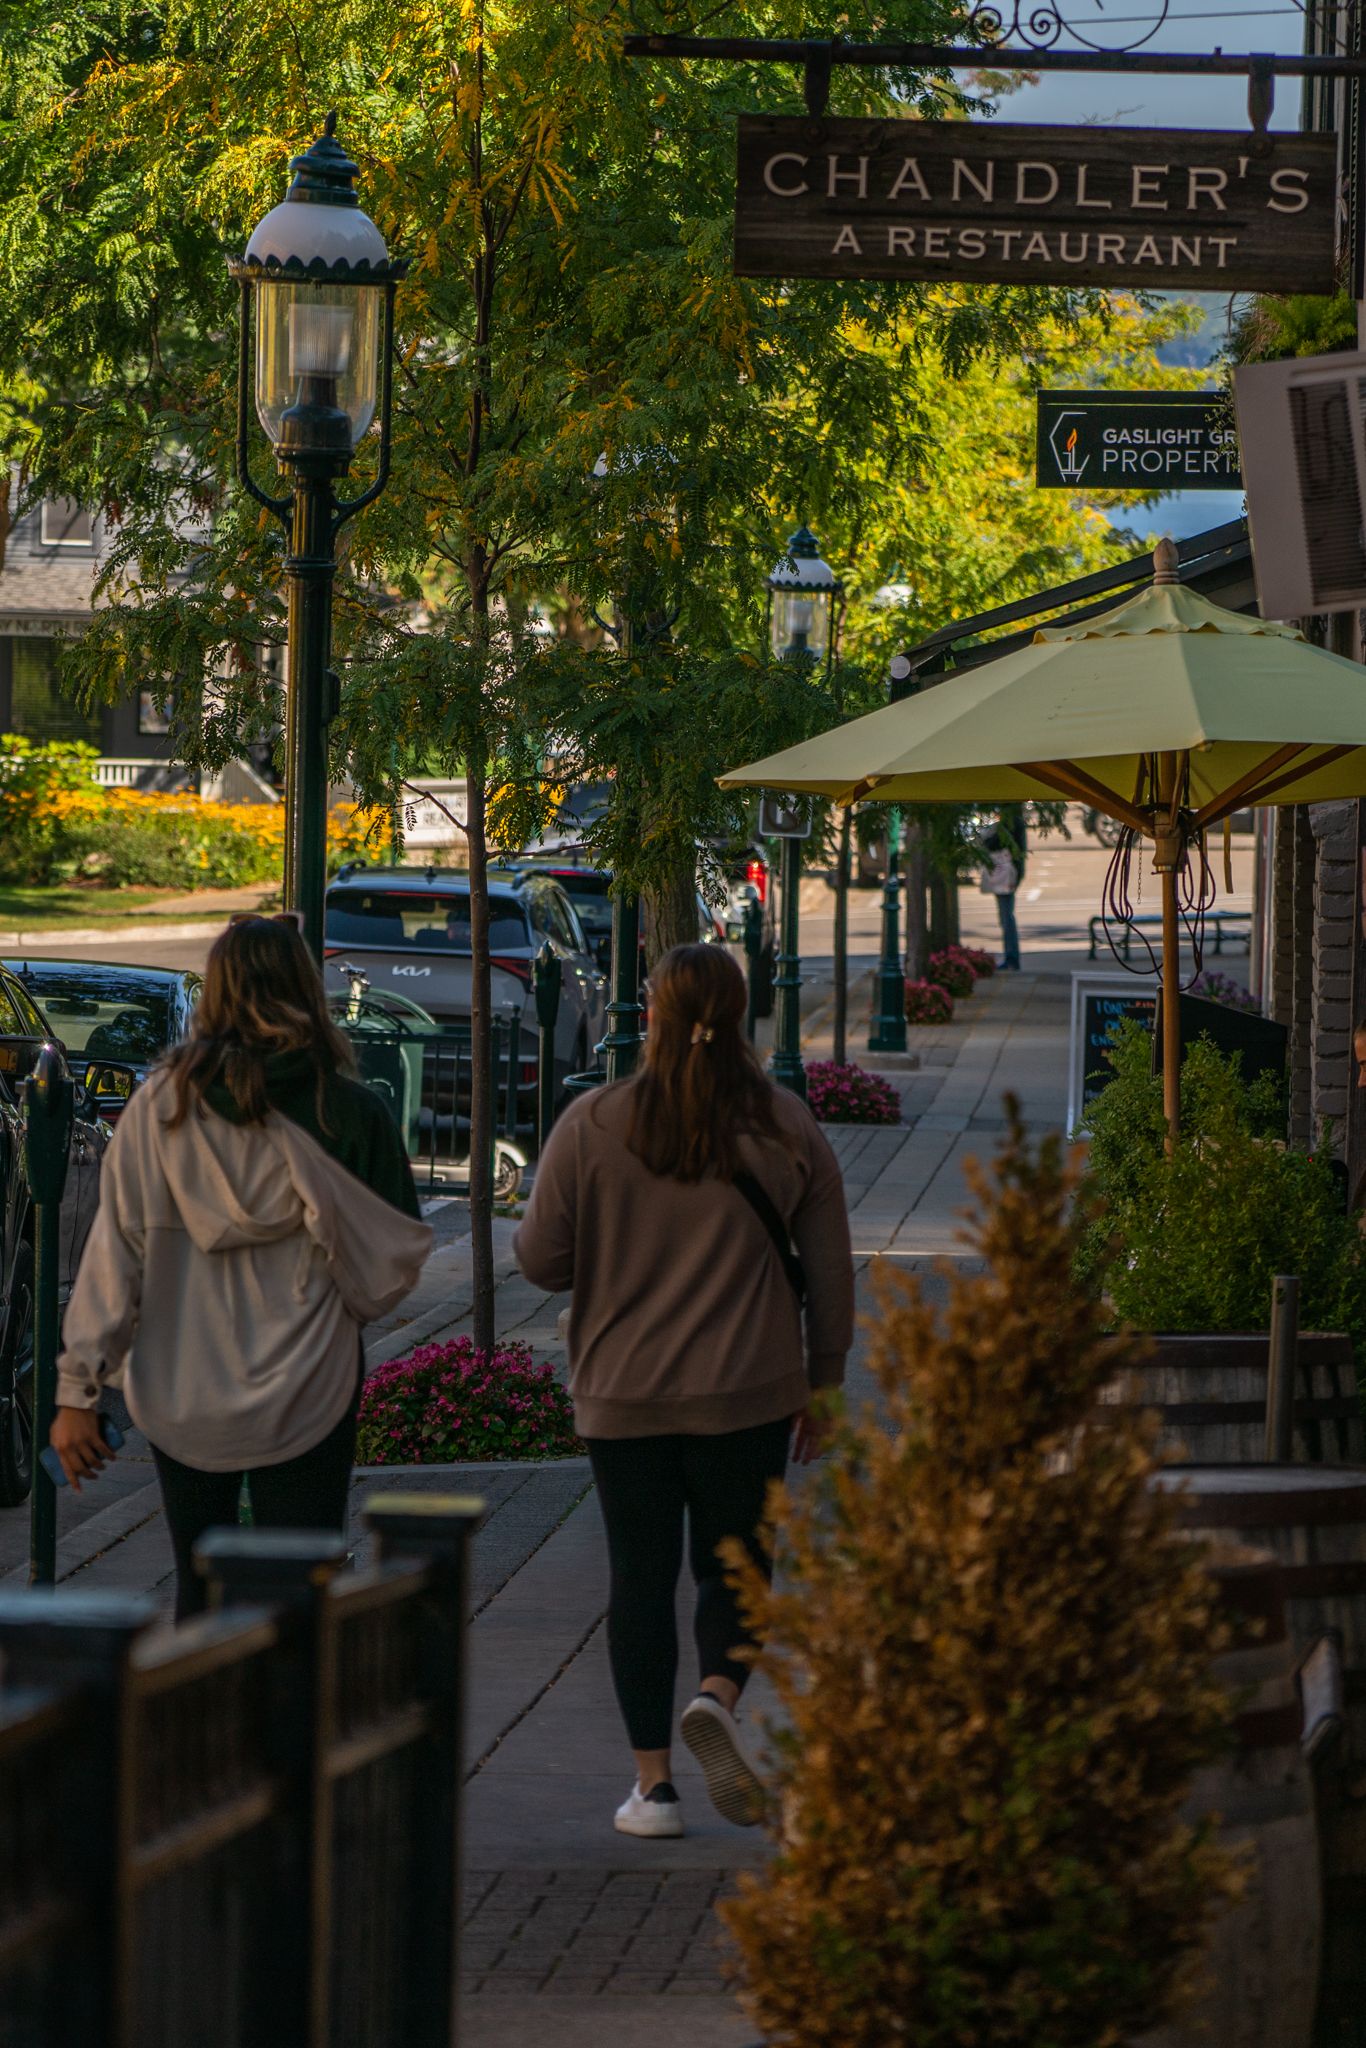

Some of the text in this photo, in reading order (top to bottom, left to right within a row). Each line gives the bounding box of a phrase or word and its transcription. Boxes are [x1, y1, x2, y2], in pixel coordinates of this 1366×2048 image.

[763, 151, 1310, 214] CHANDLER'S
[831, 224, 1238, 268] A RESTAURANT
[1102, 428, 1236, 445] GASLIGHT GR
